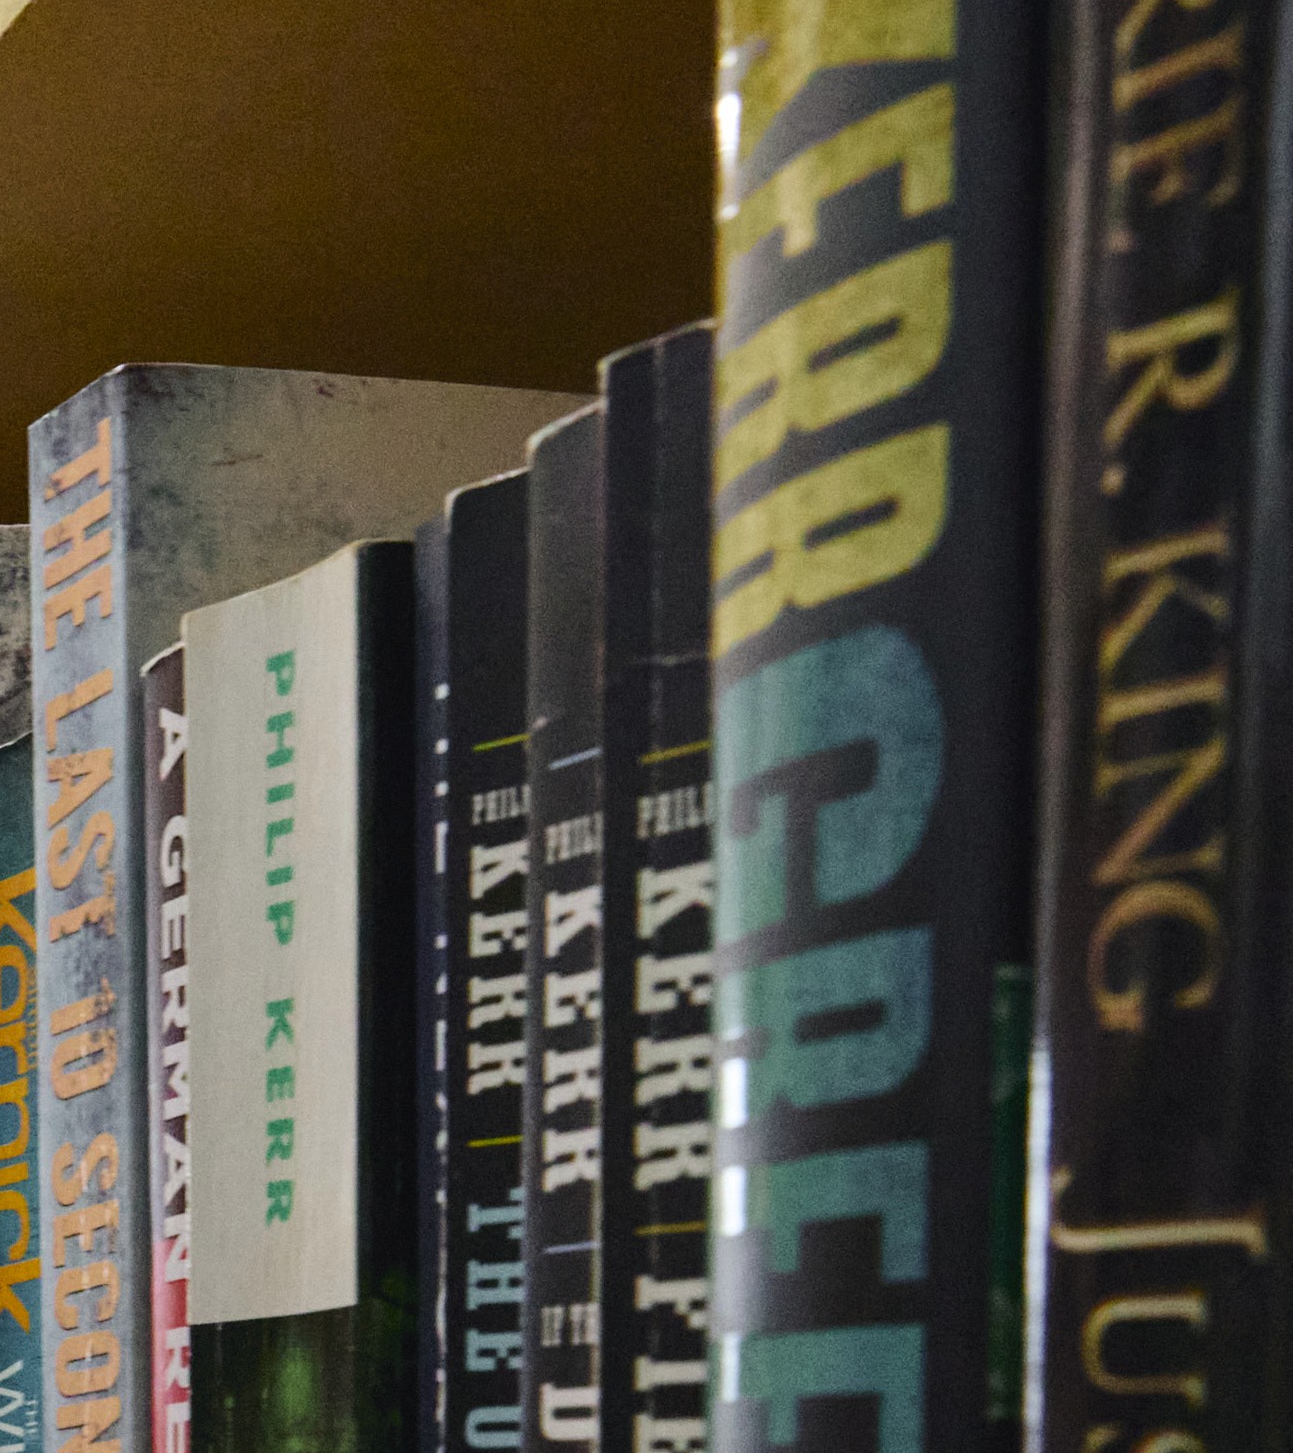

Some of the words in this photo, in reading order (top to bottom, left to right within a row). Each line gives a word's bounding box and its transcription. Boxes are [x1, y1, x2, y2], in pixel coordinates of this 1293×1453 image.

[1099, 284, 1240, 496] R.
[43, 415, 113, 652] THE
[45, 667, 117, 944] LAST
[158, 706, 190, 782] A
[263, 648, 297, 948] PHILIP
[1085, 524, 1231, 1034] KING
[159, 814, 191, 1284] GERMAN
[466, 839, 530, 1096] KERR
[542, 883, 604, 1194] KERR
[631, 855, 715, 1194] KERR
[264, 997, 297, 1226] KERR
[464, 1185, 527, 1372] THE
